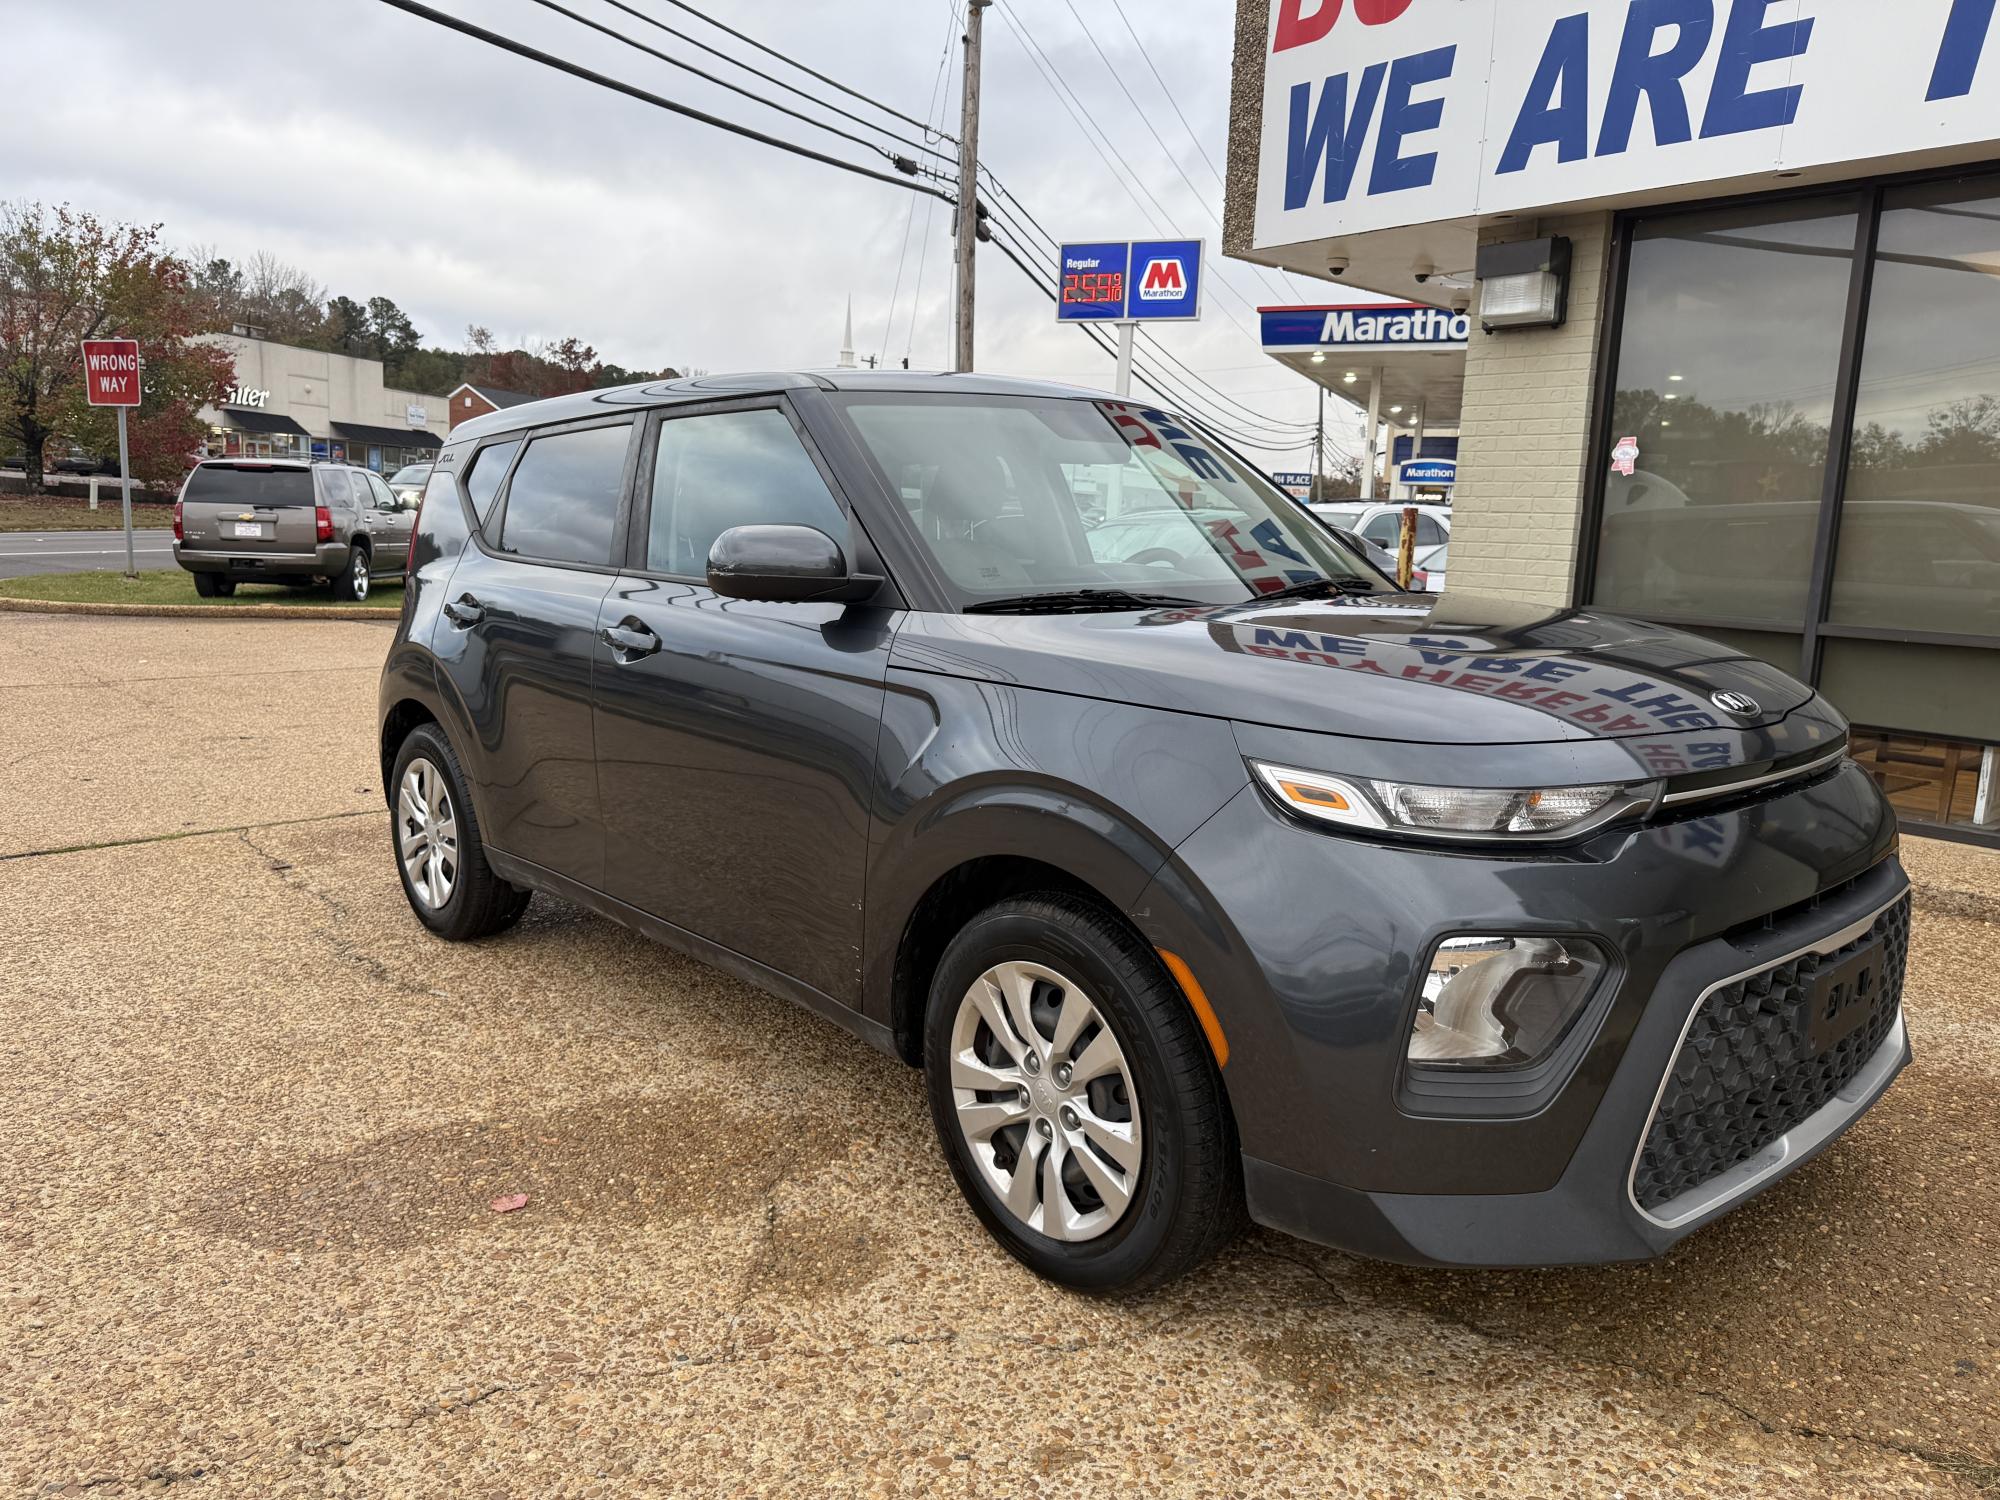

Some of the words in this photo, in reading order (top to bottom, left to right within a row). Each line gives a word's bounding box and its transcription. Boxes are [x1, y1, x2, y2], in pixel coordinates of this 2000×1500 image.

[1284, 44, 1457, 211] WE
[1495, 0, 1815, 175] ARE
[1066, 258, 1100, 270] Regular
[1143, 289, 1183, 297] Marathon
[89, 354, 136, 371] WRONG
[99, 376, 128, 393] WAY
[1405, 468, 1454, 478] Marathon
[1286, 475, 1311, 485] PLACE
